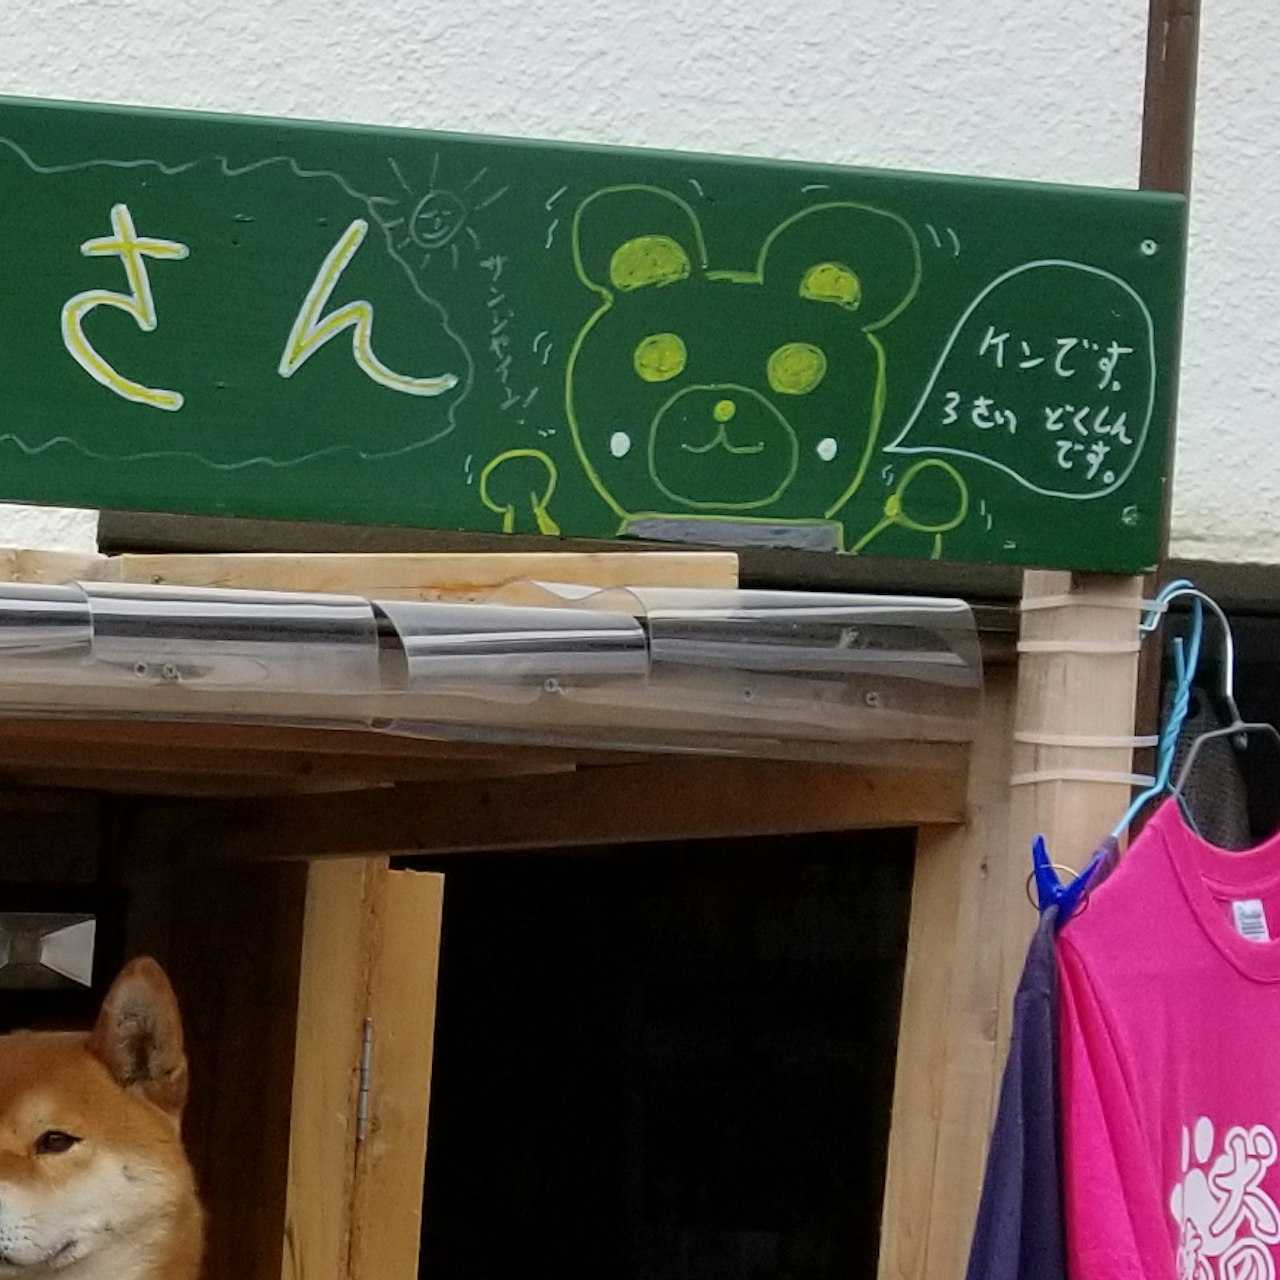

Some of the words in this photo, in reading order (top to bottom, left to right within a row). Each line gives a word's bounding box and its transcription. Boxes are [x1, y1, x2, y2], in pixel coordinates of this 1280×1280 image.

[980, 326, 1134, 392] ケンです。
[1055, 440, 1116, 484] です。
